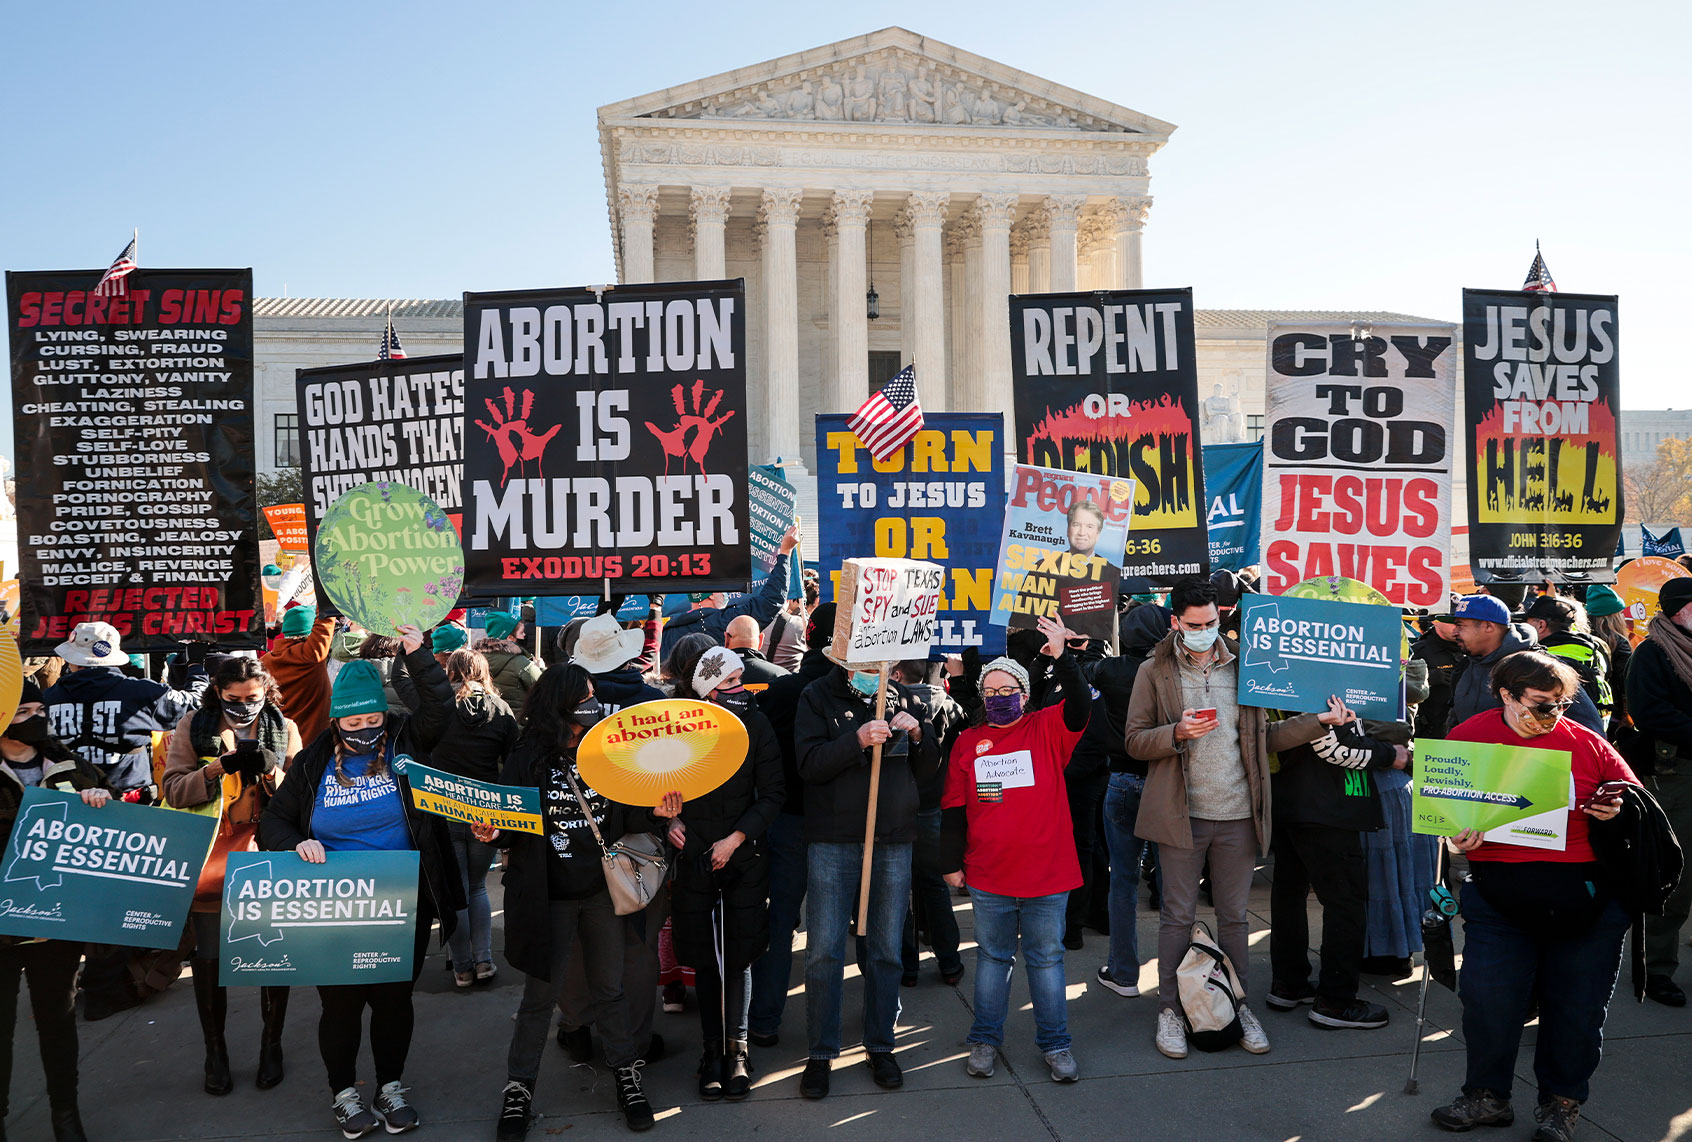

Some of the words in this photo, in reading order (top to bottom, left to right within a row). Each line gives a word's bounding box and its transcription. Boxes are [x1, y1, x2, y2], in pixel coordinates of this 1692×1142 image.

[18, 289, 151, 327] SECRET
[158, 289, 244, 325] SINS
[35, 331, 105, 342] LYING,
[114, 329, 228, 342] SWEARING
[473, 297, 735, 380] ABORTION
[1023, 302, 1182, 376] REPENT
[1474, 305, 1614, 364] JESUS
[39, 344, 145, 357] CURSING,
[151, 343, 224, 354] FRAUD
[1272, 332, 1451, 379] CRY
[38, 359, 100, 371] LUST,
[109, 357, 225, 370] EXTORTION
[33, 373, 150, 386] GLUTTONY,
[155, 372, 232, 383] VANITY
[1493, 361, 1599, 402] SAVES
[81, 386, 183, 399] LAZINESS
[305, 379, 364, 427] GOD
[369, 369, 465, 422] HATES
[1316, 384, 1403, 418] TO
[22, 401, 136, 414] CHEATING,
[144, 399, 245, 411] STEALING
[1083, 393, 1133, 420] OR
[1503, 400, 1589, 435] FROM
[50, 414, 213, 428] EXAGGERATION
[81, 427, 183, 439] SELF-PITY
[575, 389, 631, 462] IS
[76, 440, 188, 452] SELF-LOVE
[308, 422, 398, 473] HANDS
[1271, 416, 1446, 464] GOD
[52, 452, 211, 466] STUBBORNESS
[62, 478, 204, 491] FORNICATION
[85, 466, 183, 478] UNBELIEF
[1486, 437, 1610, 513] HELL
[52, 491, 213, 504] PORNOGRAPHY
[836, 482, 877, 509] TO
[887, 482, 986, 509] JESUS
[1274, 474, 1439, 538] JESUS
[55, 505, 131, 517] PRIDE,
[138, 504, 212, 515] GOSSIP
[350, 497, 428, 530] Grow
[471, 473, 739, 551] MURDER
[50, 518, 220, 532] COVETOUSNESS
[1008, 528, 1066, 546] Kavanaugh
[1024, 521, 1053, 536] Brett
[29, 533, 146, 546] BOASTING,
[154, 530, 243, 542] JEALOSY
[321, 524, 456, 552] Abortion
[874, 517, 949, 560] OR
[1509, 533, 1537, 548] JOHN
[36, 548, 102, 560] ENVY,
[110, 545, 236, 558] INSINCERITY
[360, 553, 459, 577] Power
[1004, 543, 1108, 581] SEXIST
[42, 561, 132, 574] MALICE,
[139, 559, 233, 571] REVENGE
[43, 573, 123, 587] DECEIT
[128, 572, 144, 584] &
[152, 571, 233, 582] FINALLY
[501, 555, 623, 580] EXODUS
[631, 553, 712, 577] 20:13
[1266, 540, 1443, 606] SAVES
[863, 566, 898, 594] STOP
[904, 568, 940, 590] TEXAS
[1000, 571, 1057, 597] MAN
[63, 586, 219, 613] REJECTED
[861, 593, 894, 624] SPY
[891, 599, 911, 619] and
[910, 593, 939, 618] SUE
[997, 592, 1060, 618] ALIVE
[142, 609, 255, 635] CHRIST
[1252, 616, 1364, 643] ABORTION
[94, 642, 112, 655] JESUS
[854, 628, 898, 650] abortion
[1252, 633, 1272, 651] IS
[1278, 636, 1393, 663] ESSENTIAL
[616, 716, 623, 729] i
[632, 709, 670, 727] had
[679, 708, 704, 719] an
[606, 719, 718, 744] abortion.
[980, 757, 1018, 769] Abortion
[985, 766, 1027, 780] Advocate
[323, 793, 359, 808] HUMAN
[360, 782, 398, 801] RIGHTS
[424, 774, 502, 803] ABORTION
[506, 793, 523, 805] IS
[445, 790, 477, 806] HEALTH
[479, 800, 502, 810] CARE
[1422, 785, 1484, 800] PRO-ABORTION
[1484, 791, 1518, 804] ACCESS
[420, 798, 430, 809] A
[433, 802, 484, 824] HUMAN
[489, 818, 537, 830] RIGHT
[27, 817, 168, 856] ABORTION
[1523, 826, 1554, 836] FORWARD
[21, 839, 49, 861] IS
[54, 843, 191, 881] ESSENTIAL
[238, 878, 375, 899] ABORTION
[123, 916, 173, 927] REPRODUCTIVE
[125, 910, 152, 919] CENTER
[237, 901, 262, 921] IS
[271, 899, 408, 920] ESSENTIAL
[122, 922, 146, 931] RIGHTS
